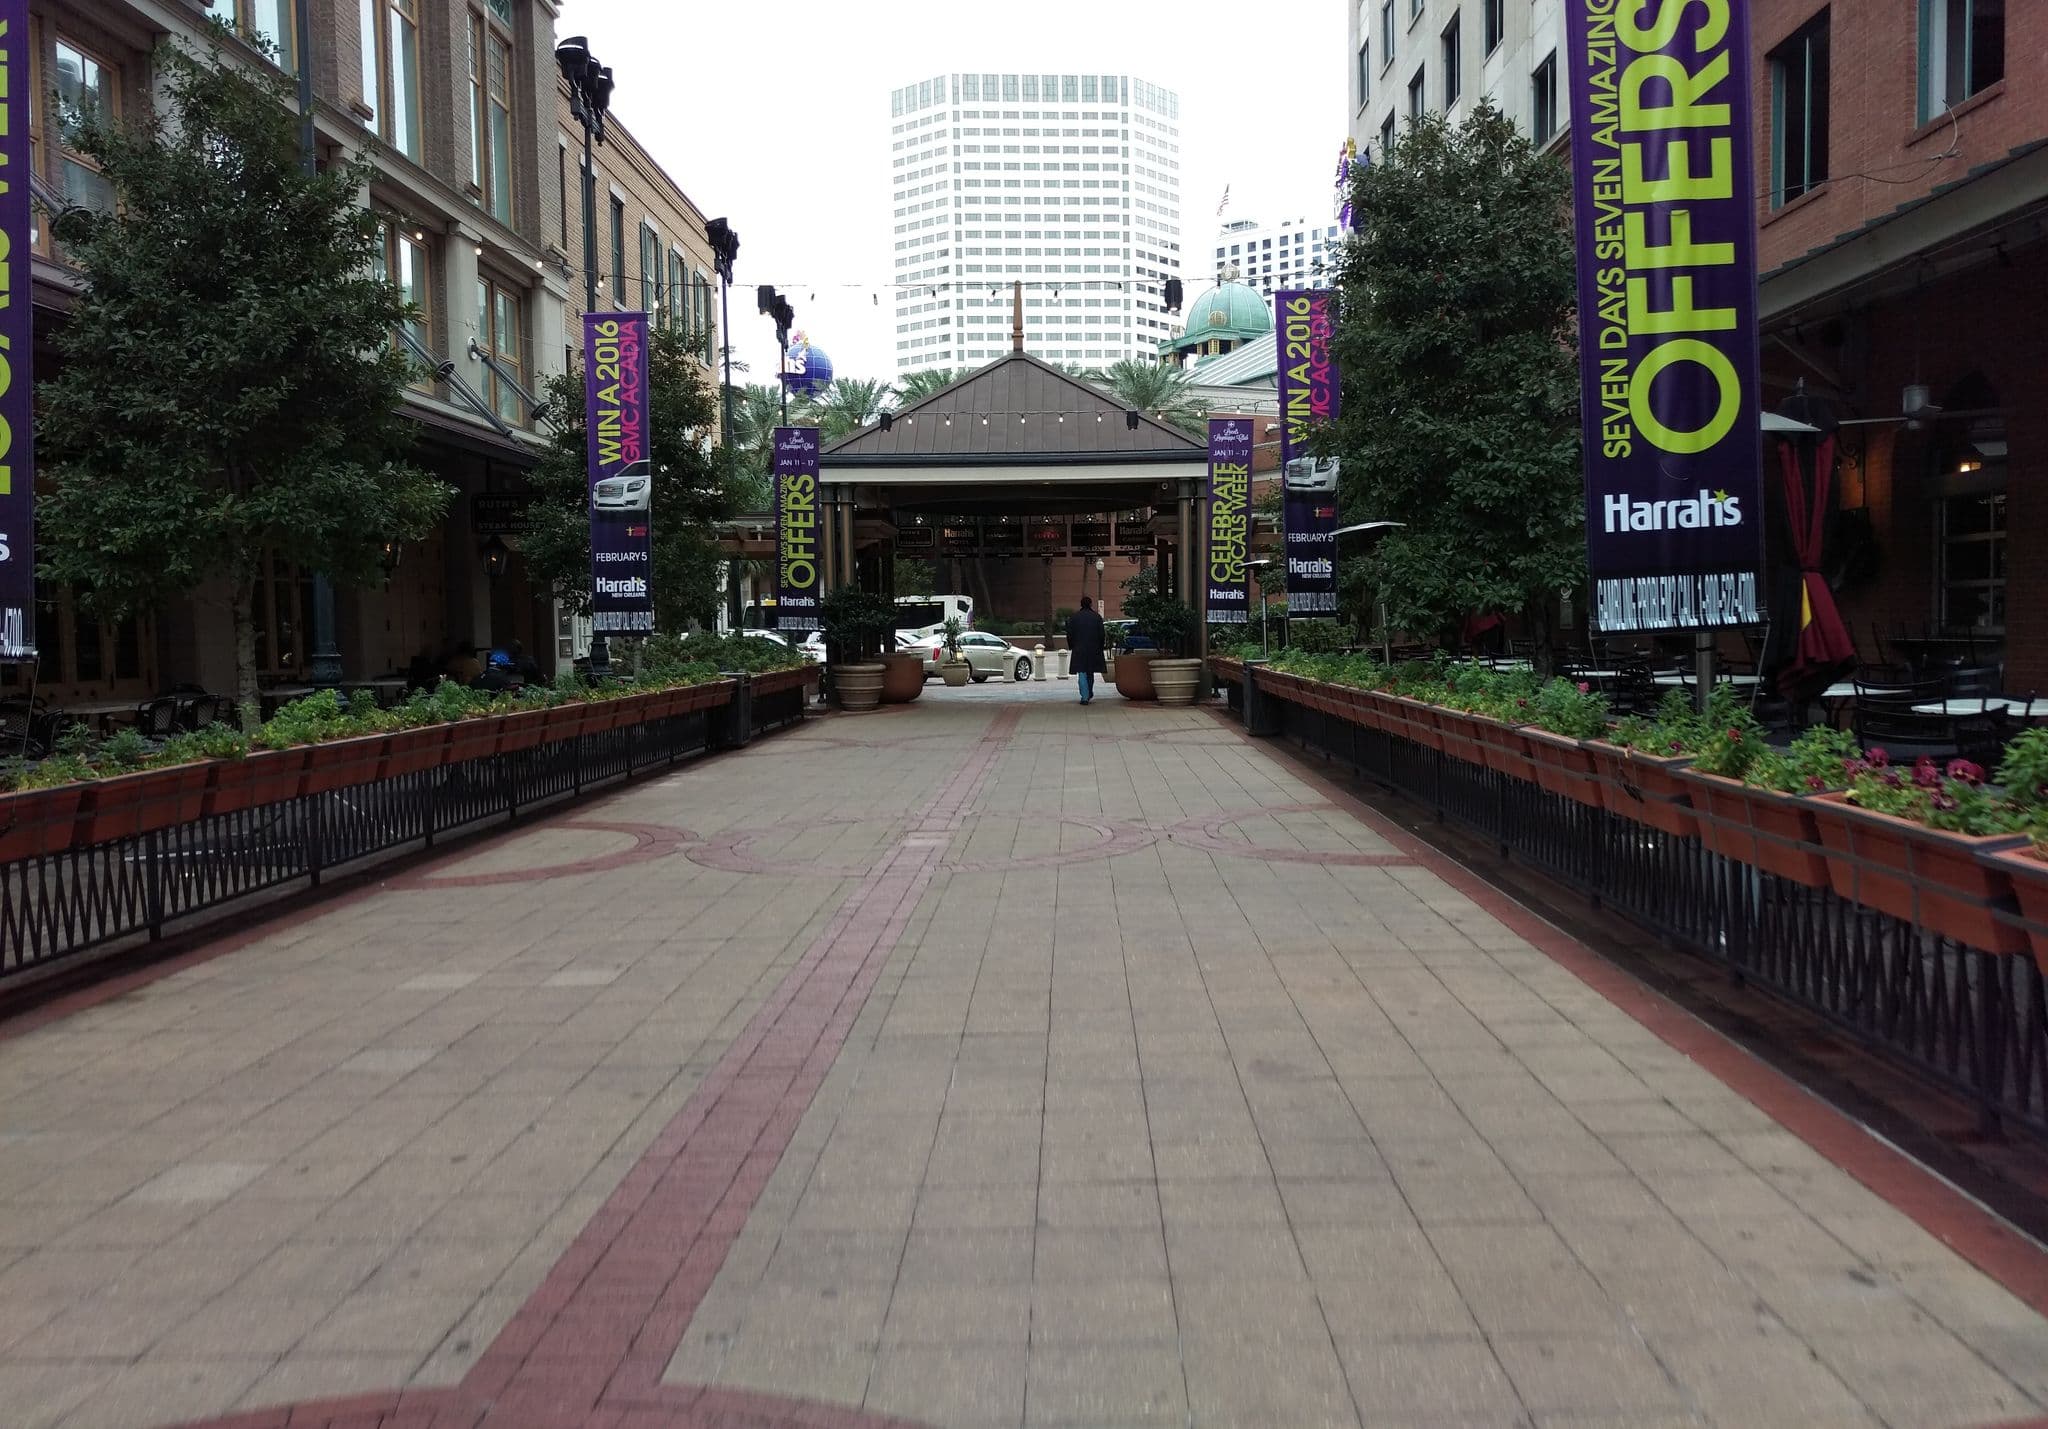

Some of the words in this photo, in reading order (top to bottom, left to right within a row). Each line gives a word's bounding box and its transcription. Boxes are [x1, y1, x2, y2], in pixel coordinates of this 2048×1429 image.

[1592, 162, 1623, 259] SEVEN
[1614, 0, 1741, 454] OFFERS
[1286, 297, 1311, 359] 2016
[1597, 264, 1628, 349] DAYS
[594, 320, 620, 381] 2016
[620, 320, 639, 405] ACADIA
[1287, 361, 1311, 385] A
[597, 383, 621, 406] A
[1287, 389, 1311, 445] WIN
[1602, 351, 1632, 458] SEVEN
[597, 410, 621, 466] WIN
[620, 407, 640, 464] GMC
[780, 474, 788, 514] AMAZING
[1232, 463, 1248, 511] WEEK
[780, 515, 788, 540] SEVEN
[787, 474, 816, 589] OFFERS
[1211, 462, 1233, 583] CELEBRATE
[1230, 514, 1247, 583] LOCALS
[1288, 533, 1328, 542] FEBRUARY
[596, 552, 641, 562] FEBRUARY
[641, 552, 648, 561] 5
[780, 541, 788, 562] DAYS
[780, 563, 788, 588] SEVEN
